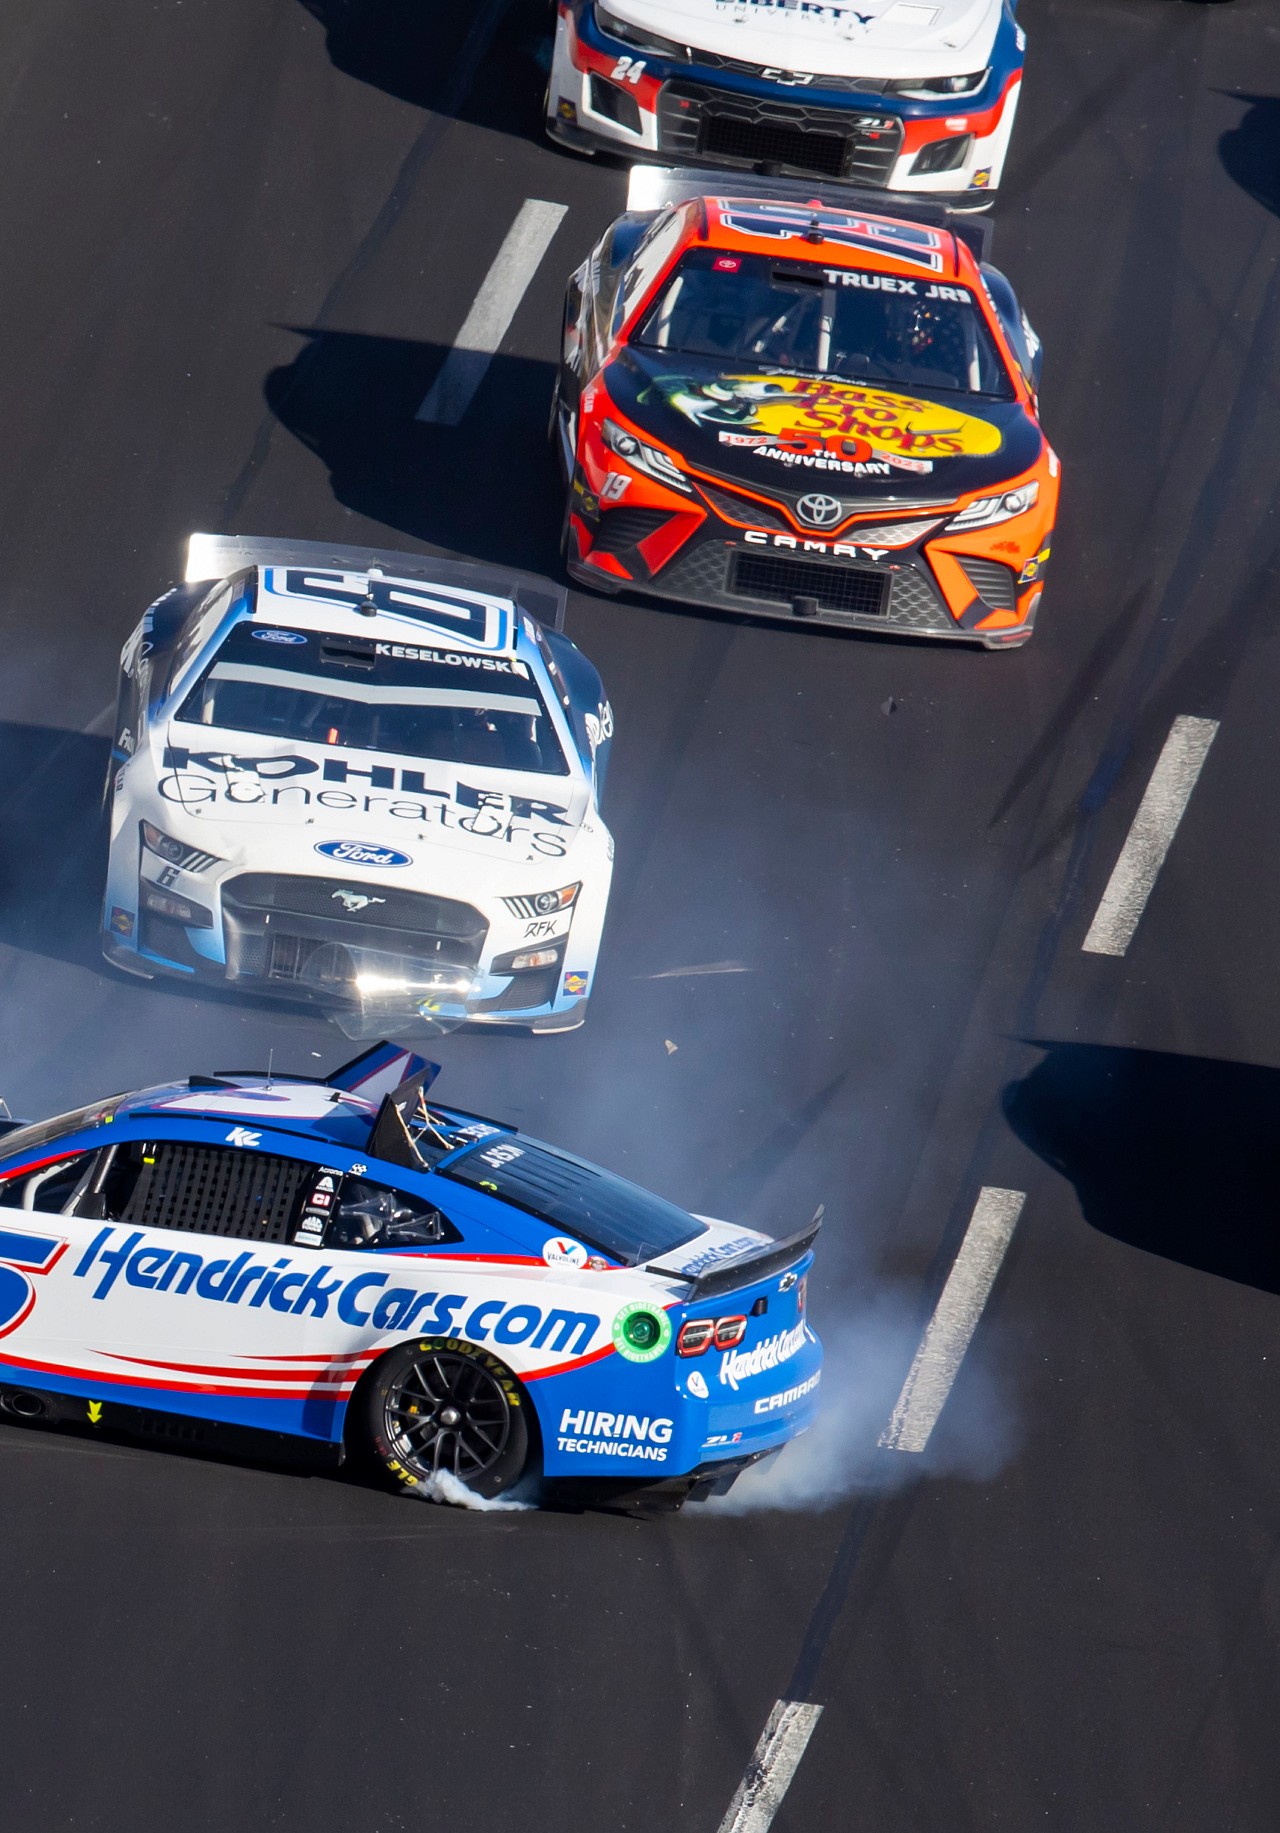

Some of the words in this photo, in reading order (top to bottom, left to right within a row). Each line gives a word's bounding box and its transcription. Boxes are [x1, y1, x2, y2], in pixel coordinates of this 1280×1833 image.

[716, 4, 871, 34] UNIVERSITY
[610, 56, 647, 84] 24
[823, 269, 917, 295] TRUEX
[791, 380, 925, 413] Bass
[795, 392, 898, 422] Pro
[725, 435, 768, 446] 1972
[778, 427, 873, 463] 50
[794, 410, 963, 454] Shops
[753, 446, 890, 475] ANNIVERSARY
[813, 449, 836, 460] TH
[600, 471, 632, 500] 19
[744, 530, 889, 561] CAMRY
[262, 631, 299, 643] Ford
[162, 746, 577, 828] KOHLER
[157, 774, 568, 859] Generators
[332, 842, 393, 866] Ford
[157, 865, 181, 887] 6
[524, 919, 557, 938] RFK
[73, 1226, 601, 1356] HendrickCars.com
[420, 1337, 521, 1407] GOODYEAR
[558, 1408, 674, 1444] HIRING
[557, 1437, 668, 1462] TECHNICIANS
